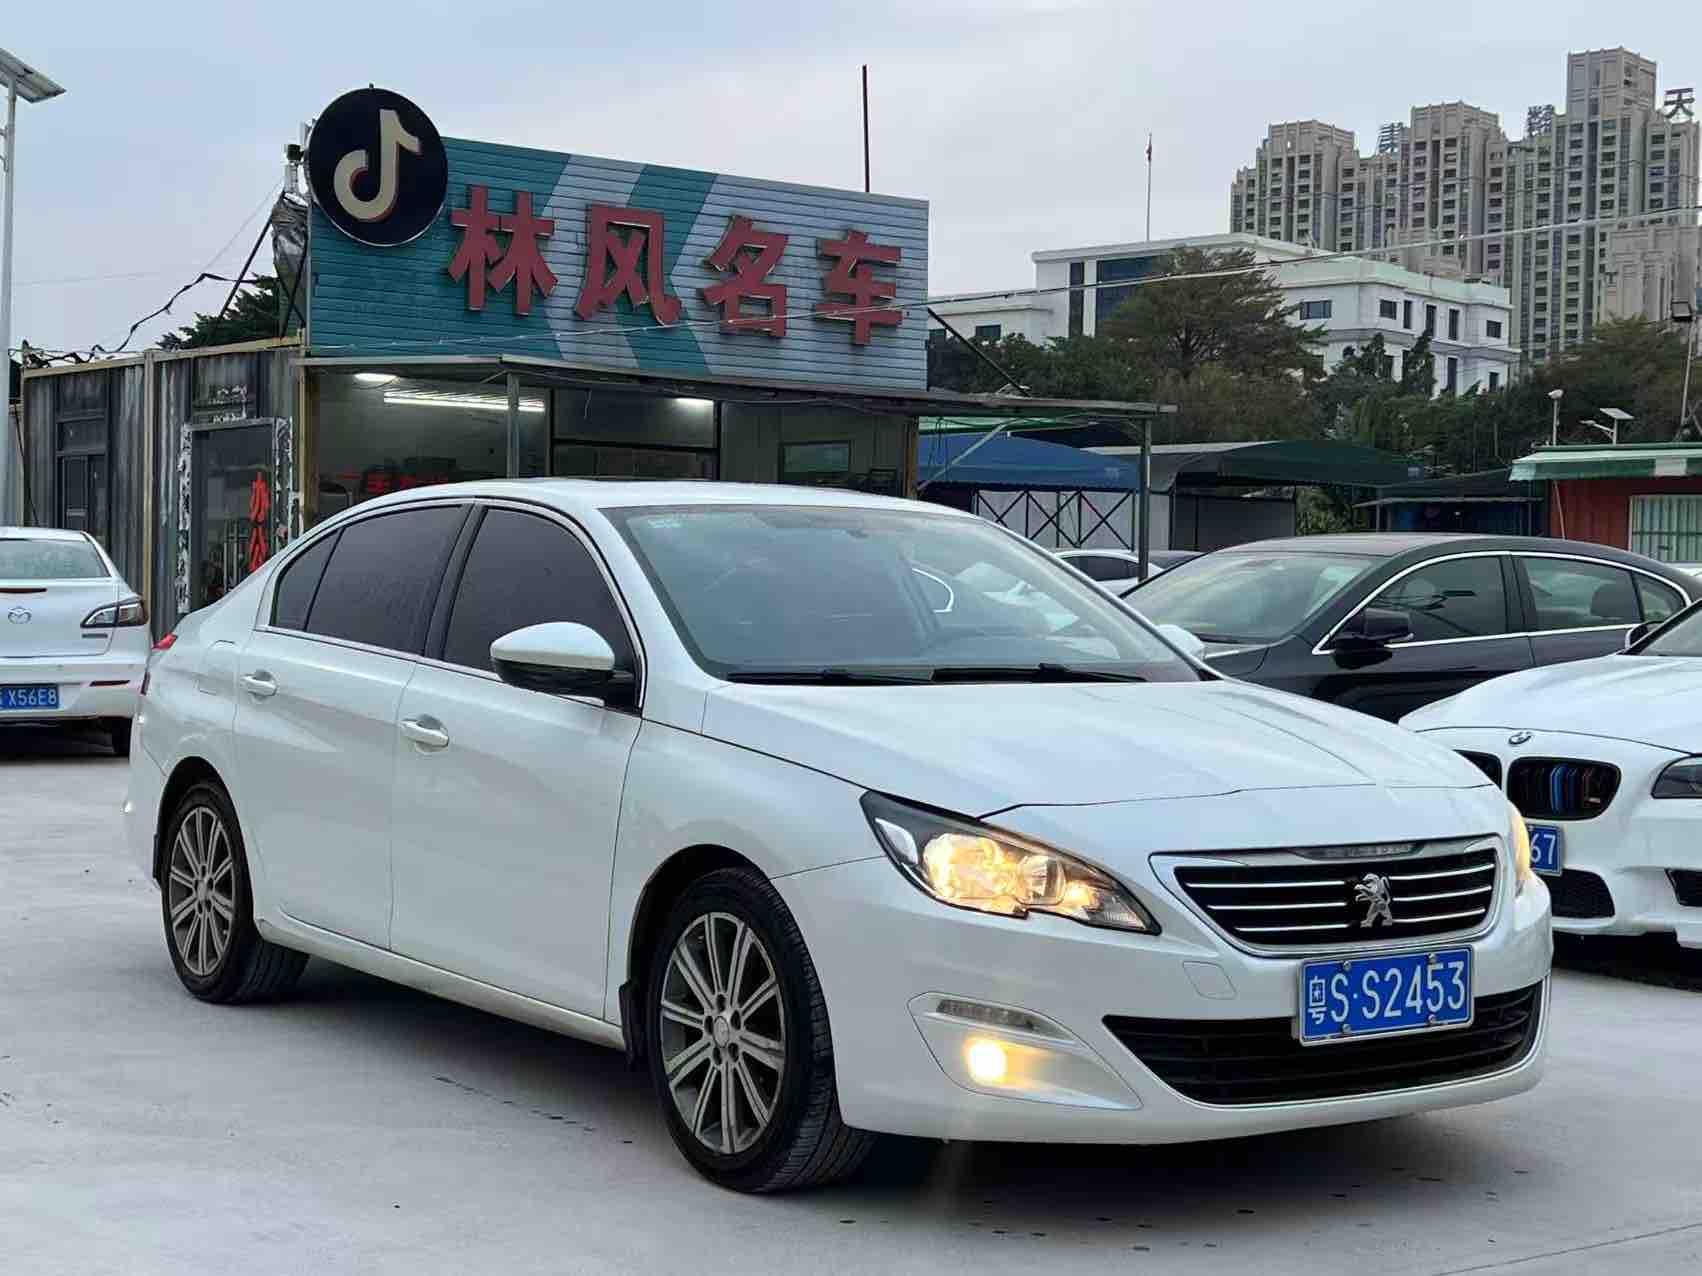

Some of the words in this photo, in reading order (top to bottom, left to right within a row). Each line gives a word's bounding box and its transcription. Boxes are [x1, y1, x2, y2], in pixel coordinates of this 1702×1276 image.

[1664, 87, 1696, 119] 天
[447, 185, 904, 346] 林风名车
